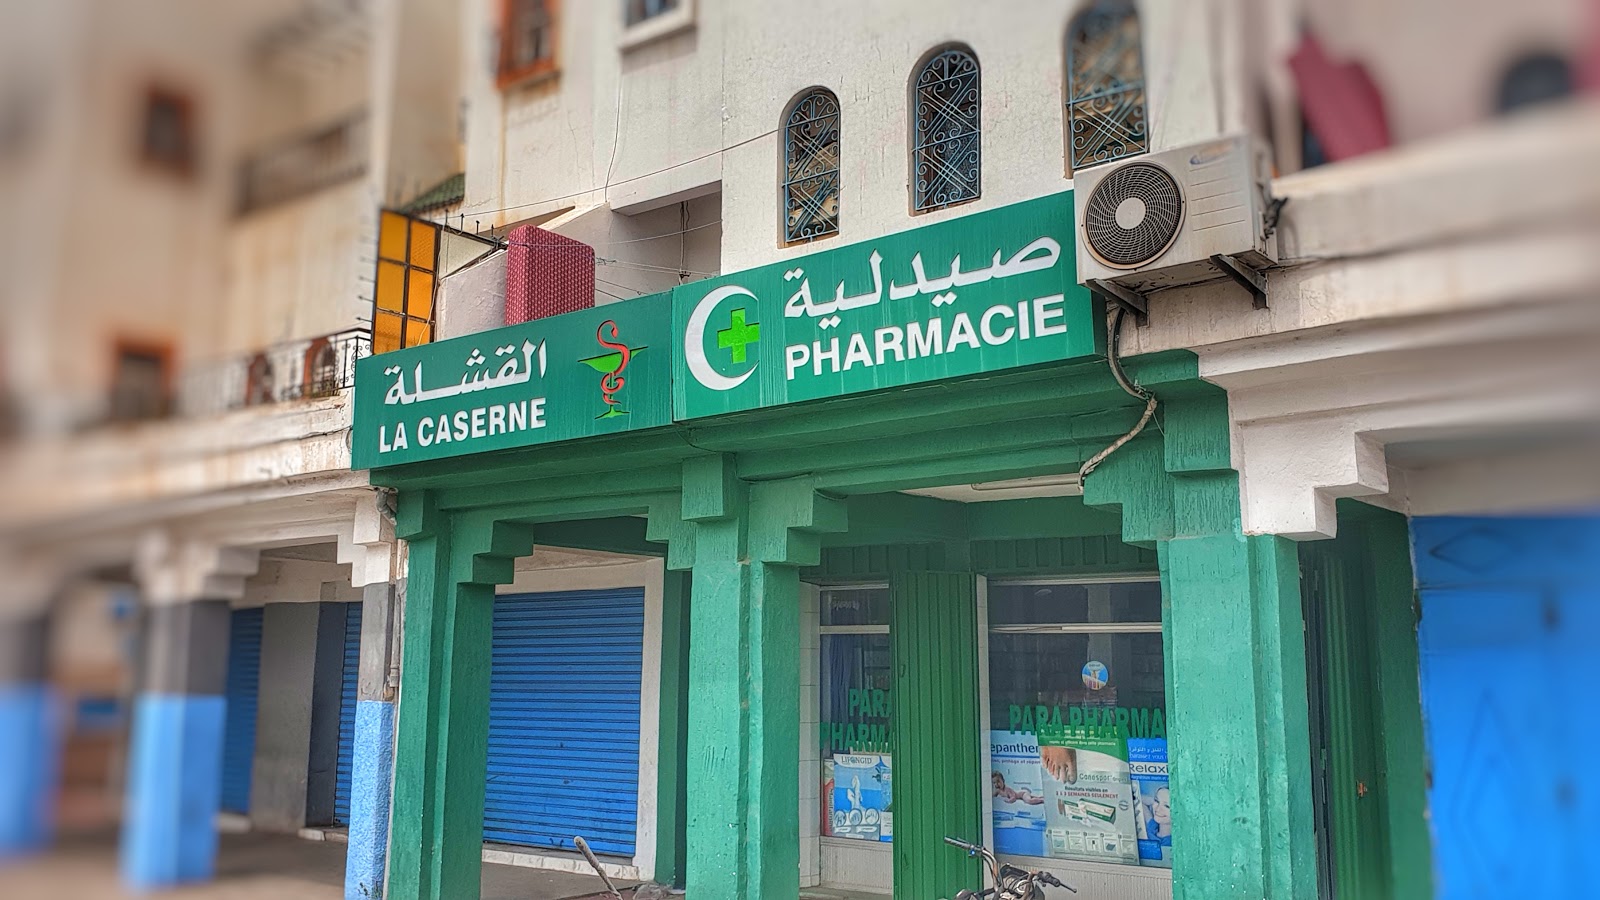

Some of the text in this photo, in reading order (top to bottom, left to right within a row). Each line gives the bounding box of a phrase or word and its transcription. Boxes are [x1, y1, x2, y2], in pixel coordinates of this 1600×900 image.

[784, 236, 1062, 330] صيدلية
[785, 293, 1068, 381] PHARMACIE
[384, 338, 547, 406] القشلة
[379, 398, 547, 454] LA CASERNE
[1009, 704, 1166, 739] PARA PHARMA
